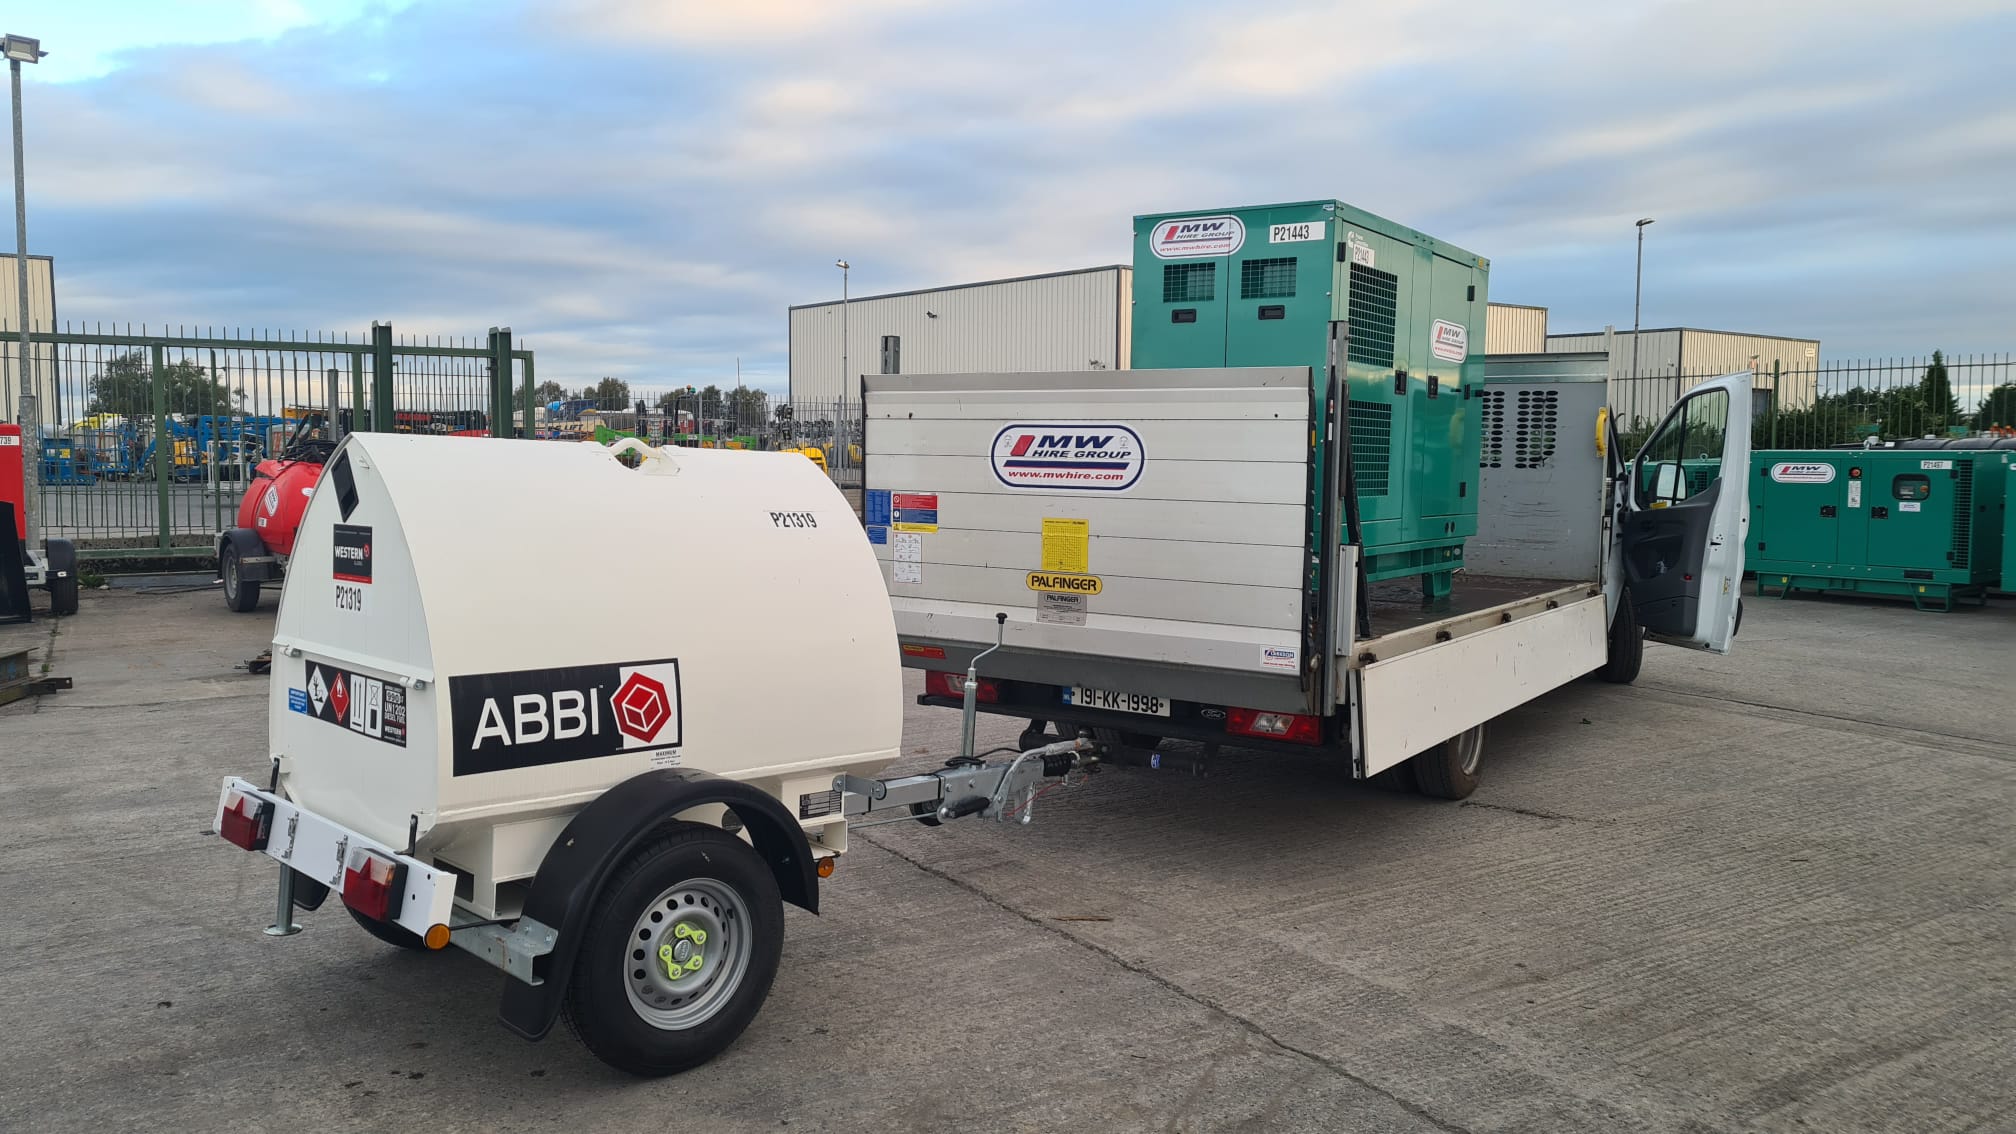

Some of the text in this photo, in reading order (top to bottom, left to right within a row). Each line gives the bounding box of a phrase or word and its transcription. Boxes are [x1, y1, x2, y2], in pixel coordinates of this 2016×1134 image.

[1180, 222, 1225, 233] MW
[1273, 224, 1310, 241] P21443
[1443, 327, 1461, 338] MW
[1037, 435, 1115, 449] MW
[1032, 450, 1132, 459] HIRE GROUP
[1008, 471, 1124, 480] www.mwhire.com
[769, 512, 817, 528] P21319
[334, 545, 364, 560] WESTERN
[1031, 575, 1097, 591] PALFINGER
[336, 585, 361, 611] P21319
[1046, 594, 1079, 603] PALFINGER
[1080, 687, 1159, 714] 191-KK-1998
[471, 687, 600, 750] ABBI
